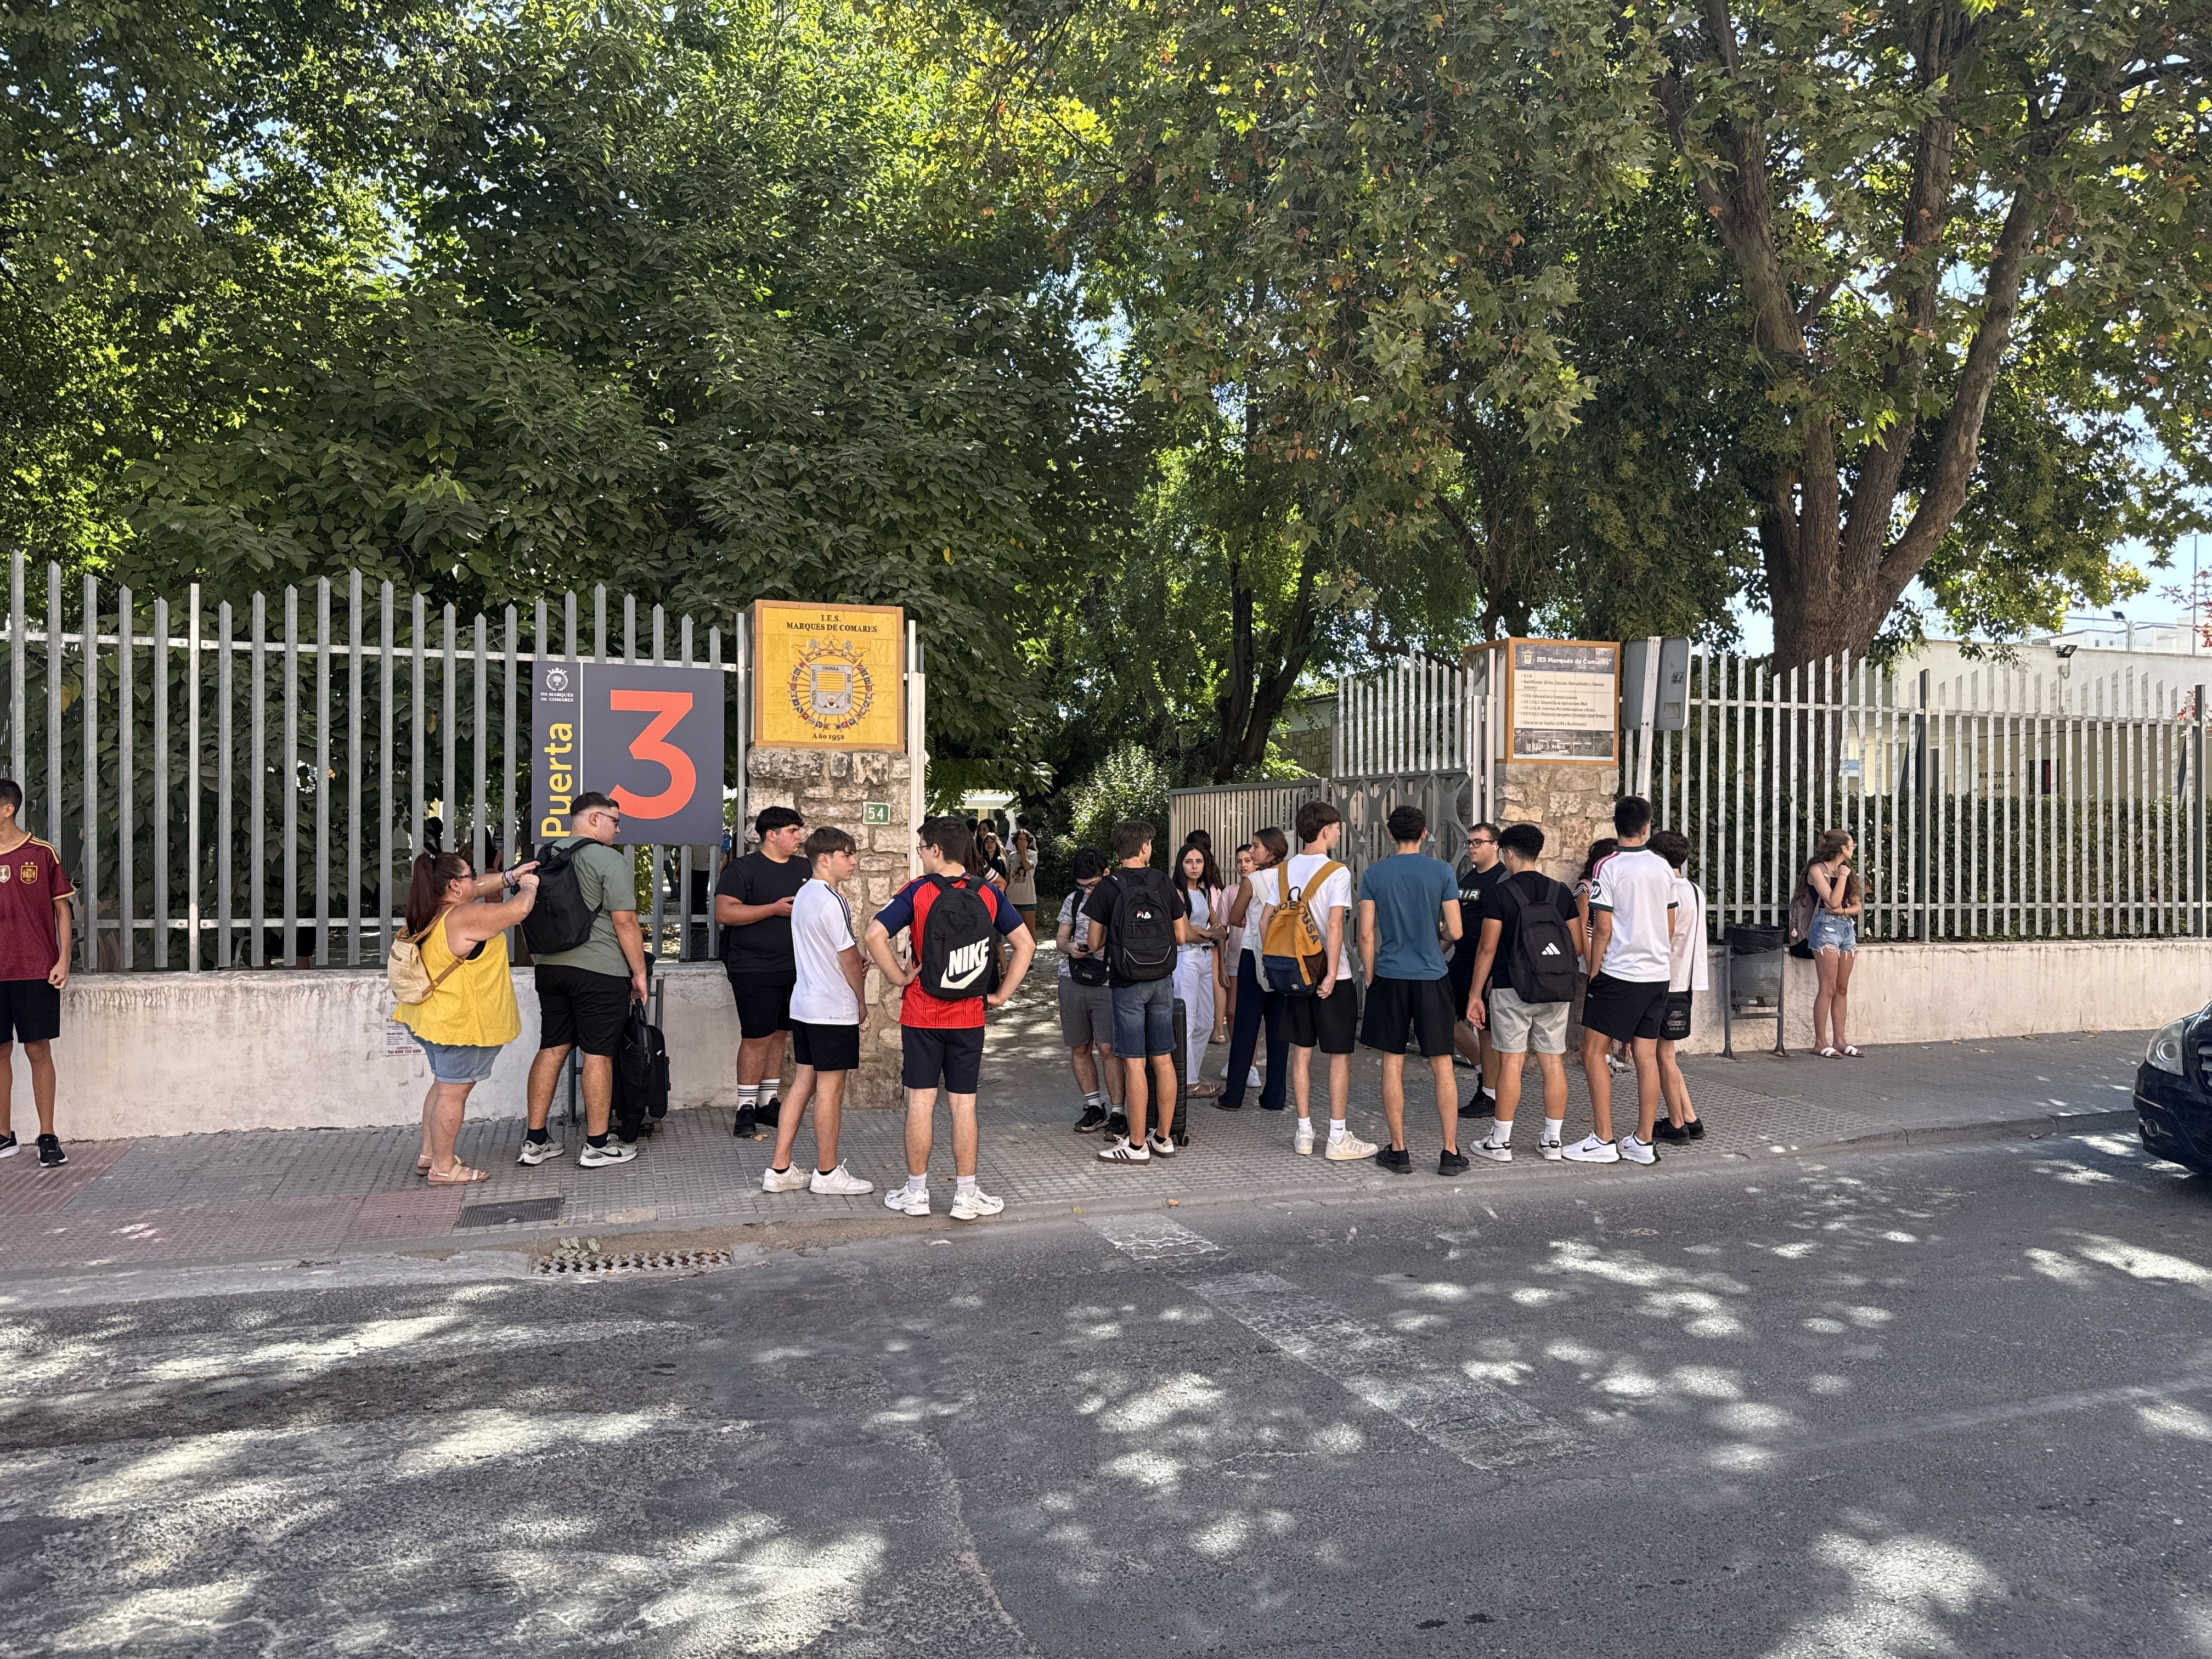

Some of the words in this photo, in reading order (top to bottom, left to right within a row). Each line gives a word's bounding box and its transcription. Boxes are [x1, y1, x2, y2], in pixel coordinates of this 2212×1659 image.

[786, 622, 825, 631] MARQUÉS
[821, 614, 841, 623] I.E.S.
[609, 690, 696, 819] 3
[541, 723, 572, 837] Puerta
[868, 808, 883, 820] 54
[948, 936, 989, 977] NIKE
